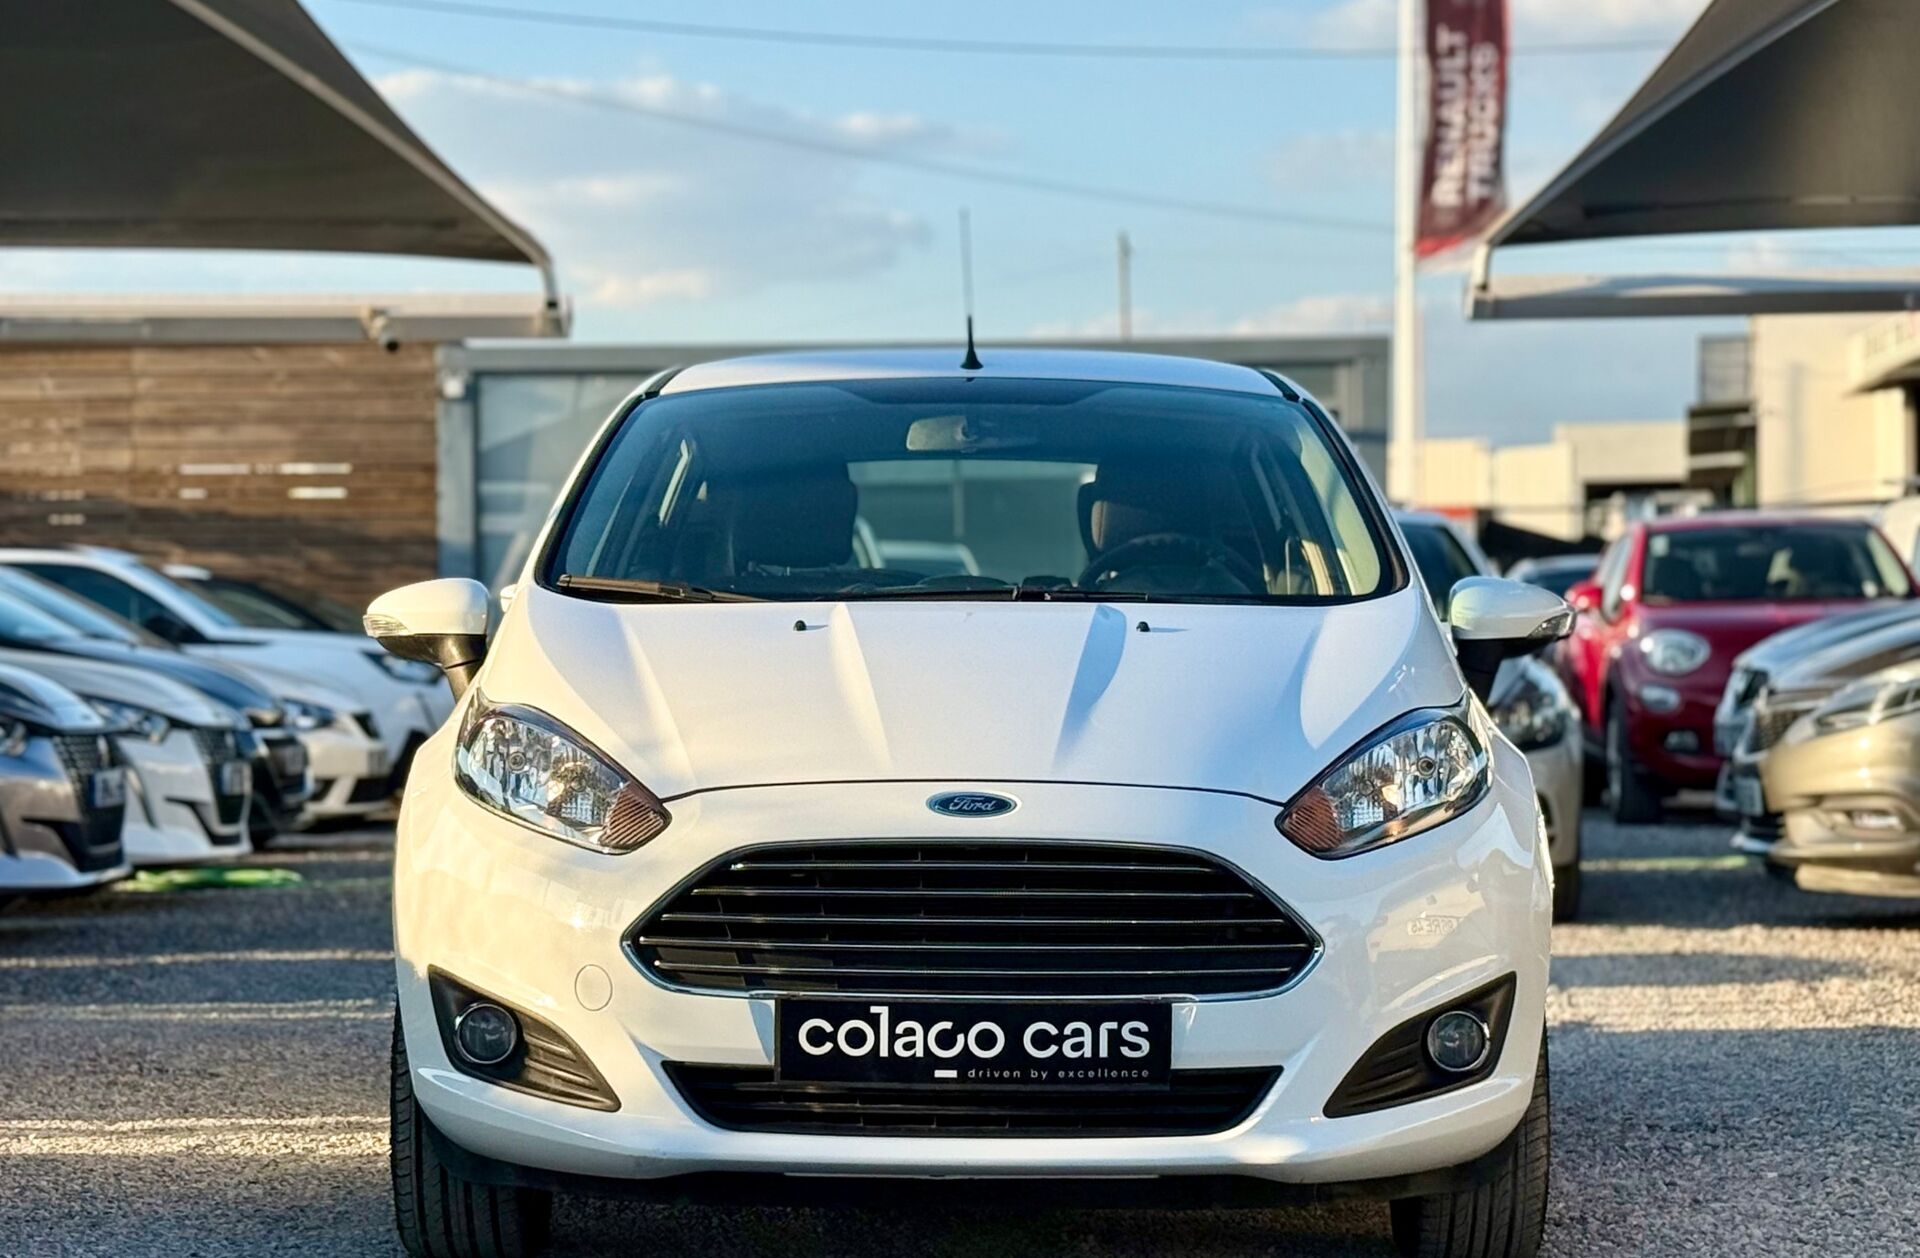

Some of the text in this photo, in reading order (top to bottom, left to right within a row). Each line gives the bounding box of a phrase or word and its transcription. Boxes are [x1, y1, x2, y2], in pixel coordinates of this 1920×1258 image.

[949, 796, 996, 811] Ford
[1023, 1020, 1151, 1059] cars
[967, 1067, 1149, 1081] driven by excellence
